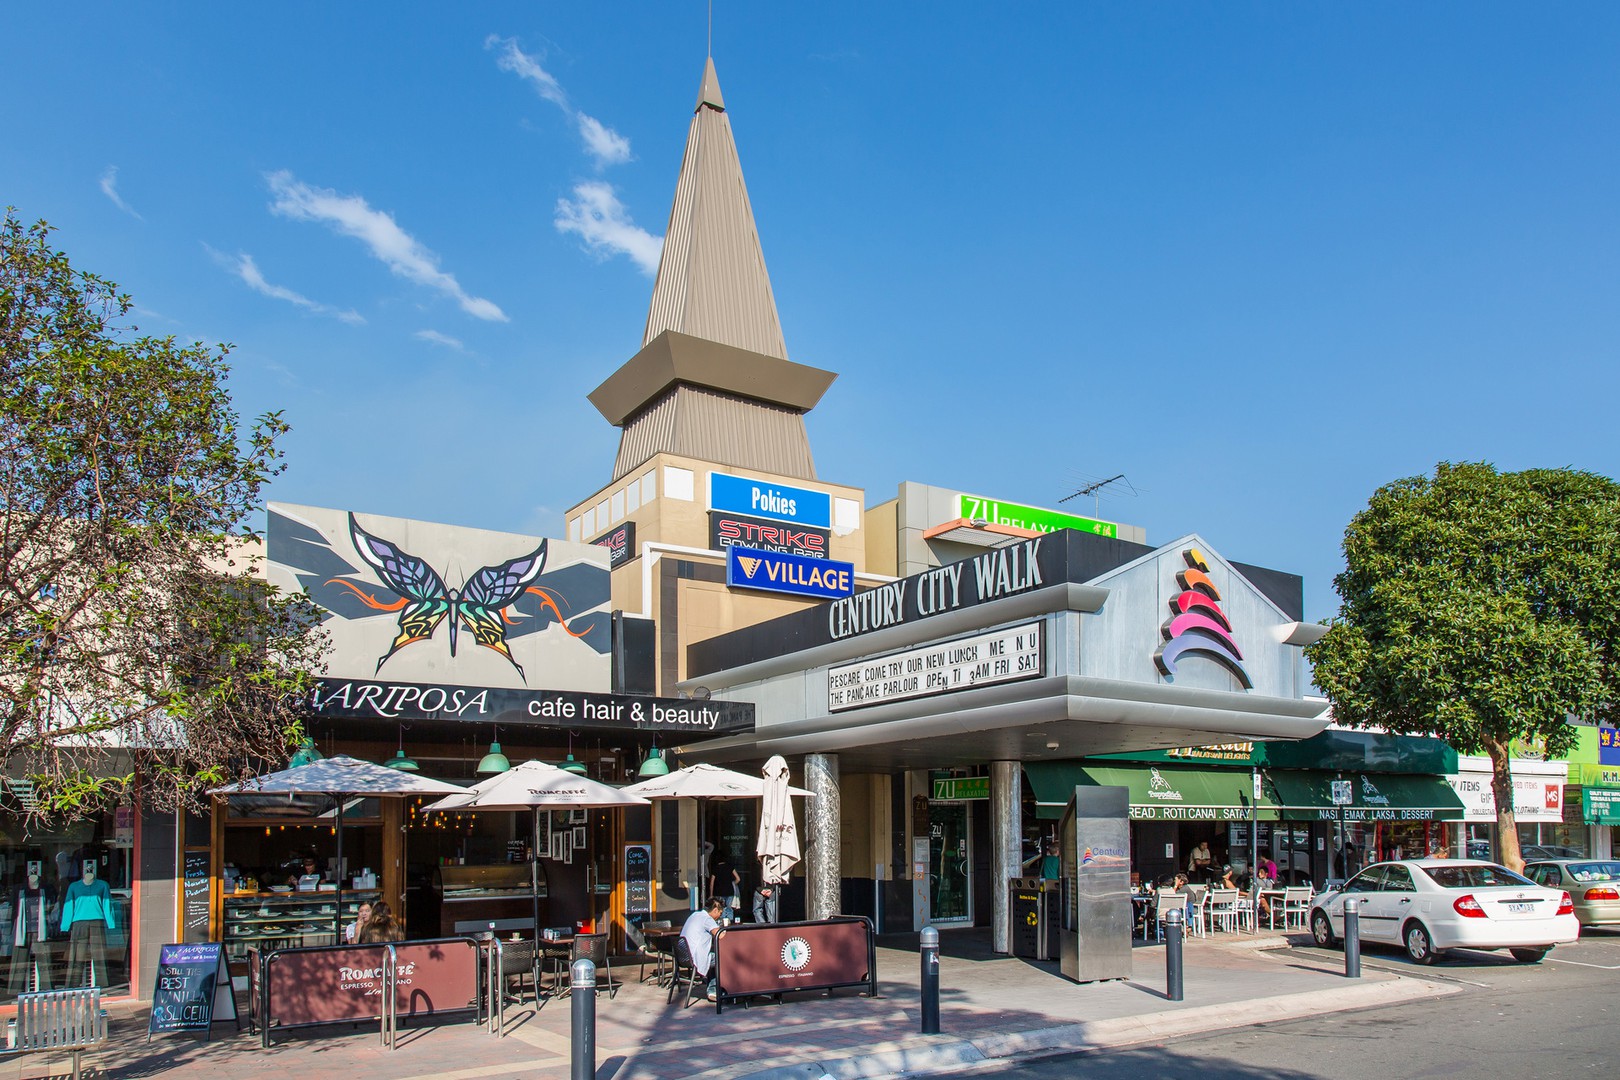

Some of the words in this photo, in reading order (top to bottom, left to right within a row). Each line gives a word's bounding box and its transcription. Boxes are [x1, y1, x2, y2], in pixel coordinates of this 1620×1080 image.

[751, 486, 797, 517] Pokies
[764, 559, 850, 592] VILLAGE
[828, 579, 907, 640] CENTURY
[916, 561, 964, 616] CITY
[973, 537, 1043, 601] WALK
[830, 670, 861, 689] PESCARE
[864, 665, 886, 682] COME
[888, 661, 904, 677] TRY
[906, 657, 923, 673] OUR
[926, 652, 945, 669] NEW
[948, 645, 978, 665] LUNCH
[830, 691, 843, 705] THE
[846, 684, 880, 702] PANCAKE
[883, 676, 918, 695] PARLOUR
[994, 658, 1010, 676] FRI
[1018, 653, 1037, 671] SAT
[527, 696, 577, 718] cafe
[583, 698, 624, 721] hair
[630, 702, 645, 722] &
[652, 703, 720, 730] beauty
[936, 781, 955, 799] ZU
[1460, 780, 1480, 791] ITEMS
[1546, 790, 1558, 802] MS
[1163, 807, 1186, 819] ROTI
[1188, 807, 1217, 819] CANAI
[1223, 808, 1251, 819] SATAY
[1319, 809, 1338, 820] NASI
[1342, 809, 1366, 820] EMAK
[1371, 809, 1396, 820] LAKSA
[1401, 809, 1434, 820] DESSERT
[932, 825, 942, 835] ZU
[1092, 847, 1126, 857] Century
[161, 976, 190, 990] BEST
[340, 980, 374, 991] ESPRESSO
[160, 990, 207, 1004] VANILLA
